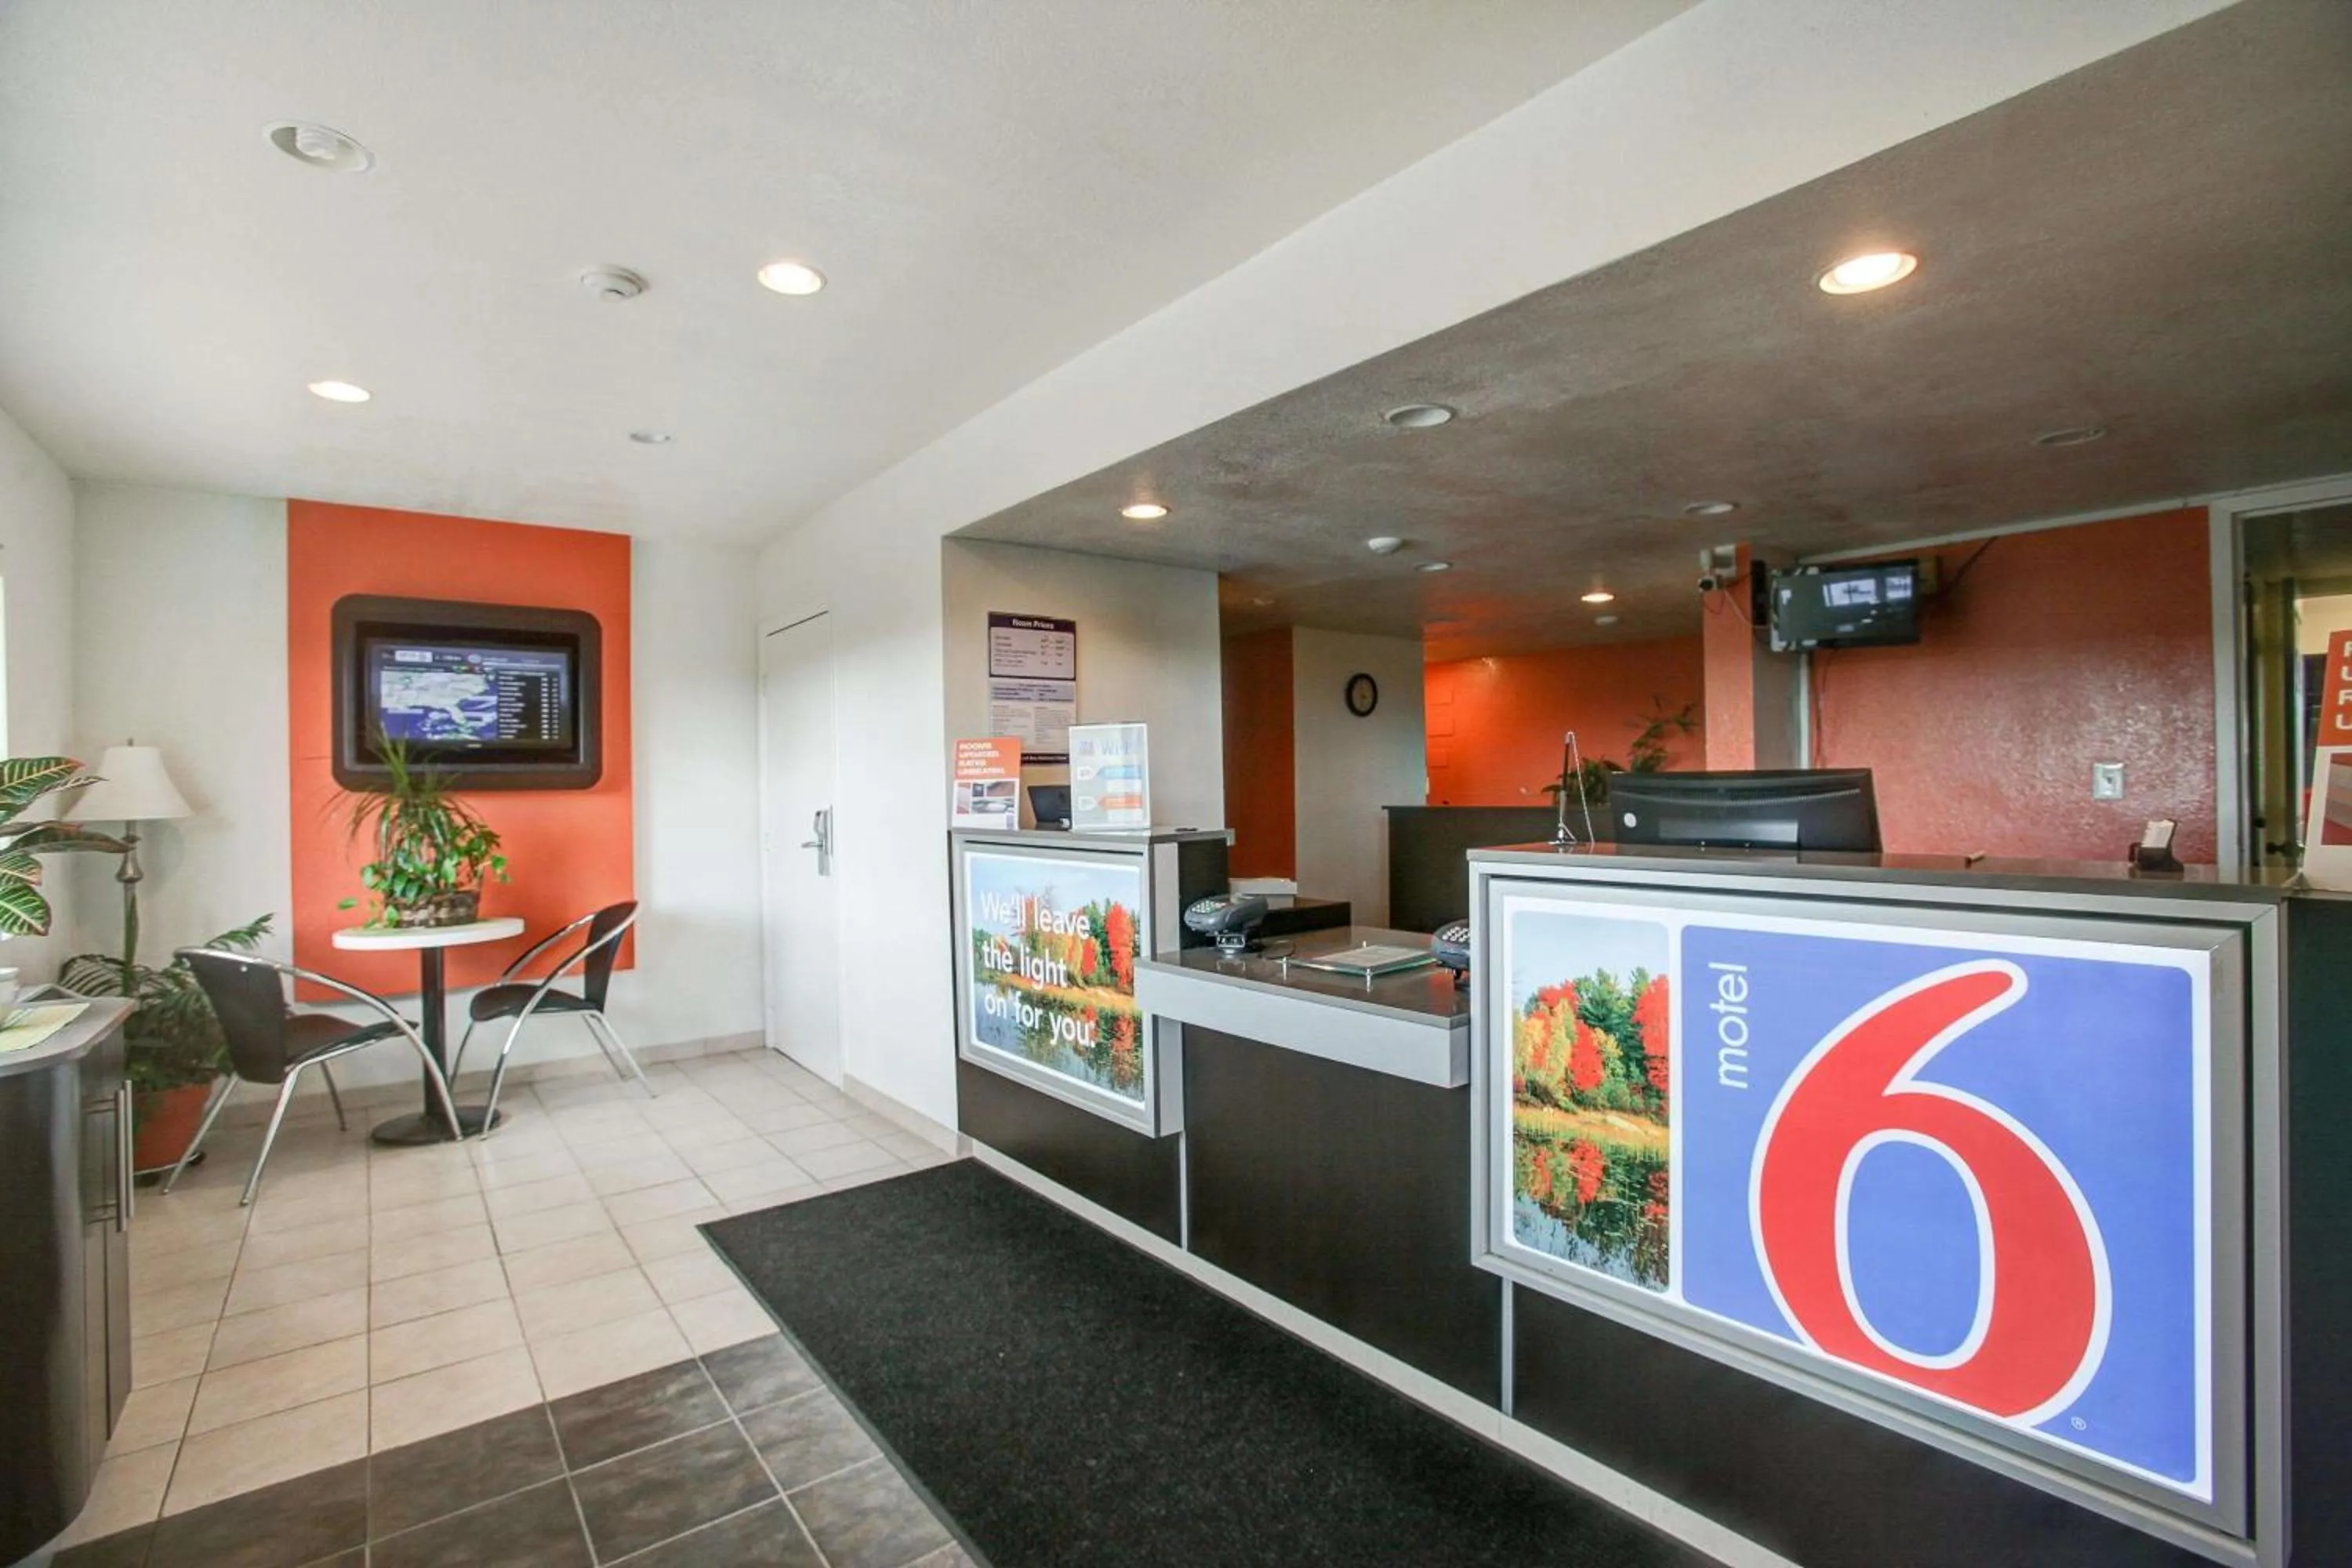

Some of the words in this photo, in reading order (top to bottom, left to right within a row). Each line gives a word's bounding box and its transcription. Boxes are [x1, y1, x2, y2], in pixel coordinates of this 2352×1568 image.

[979, 889, 1026, 931] We'll
[1034, 895, 1091, 939] leave
[982, 936, 1014, 973] the
[1020, 943, 1068, 991] light
[984, 992, 1008, 1019] on
[1013, 990, 1044, 1030] for
[1708, 961, 1749, 1090] motel
[1748, 957, 2113, 1427] 6
